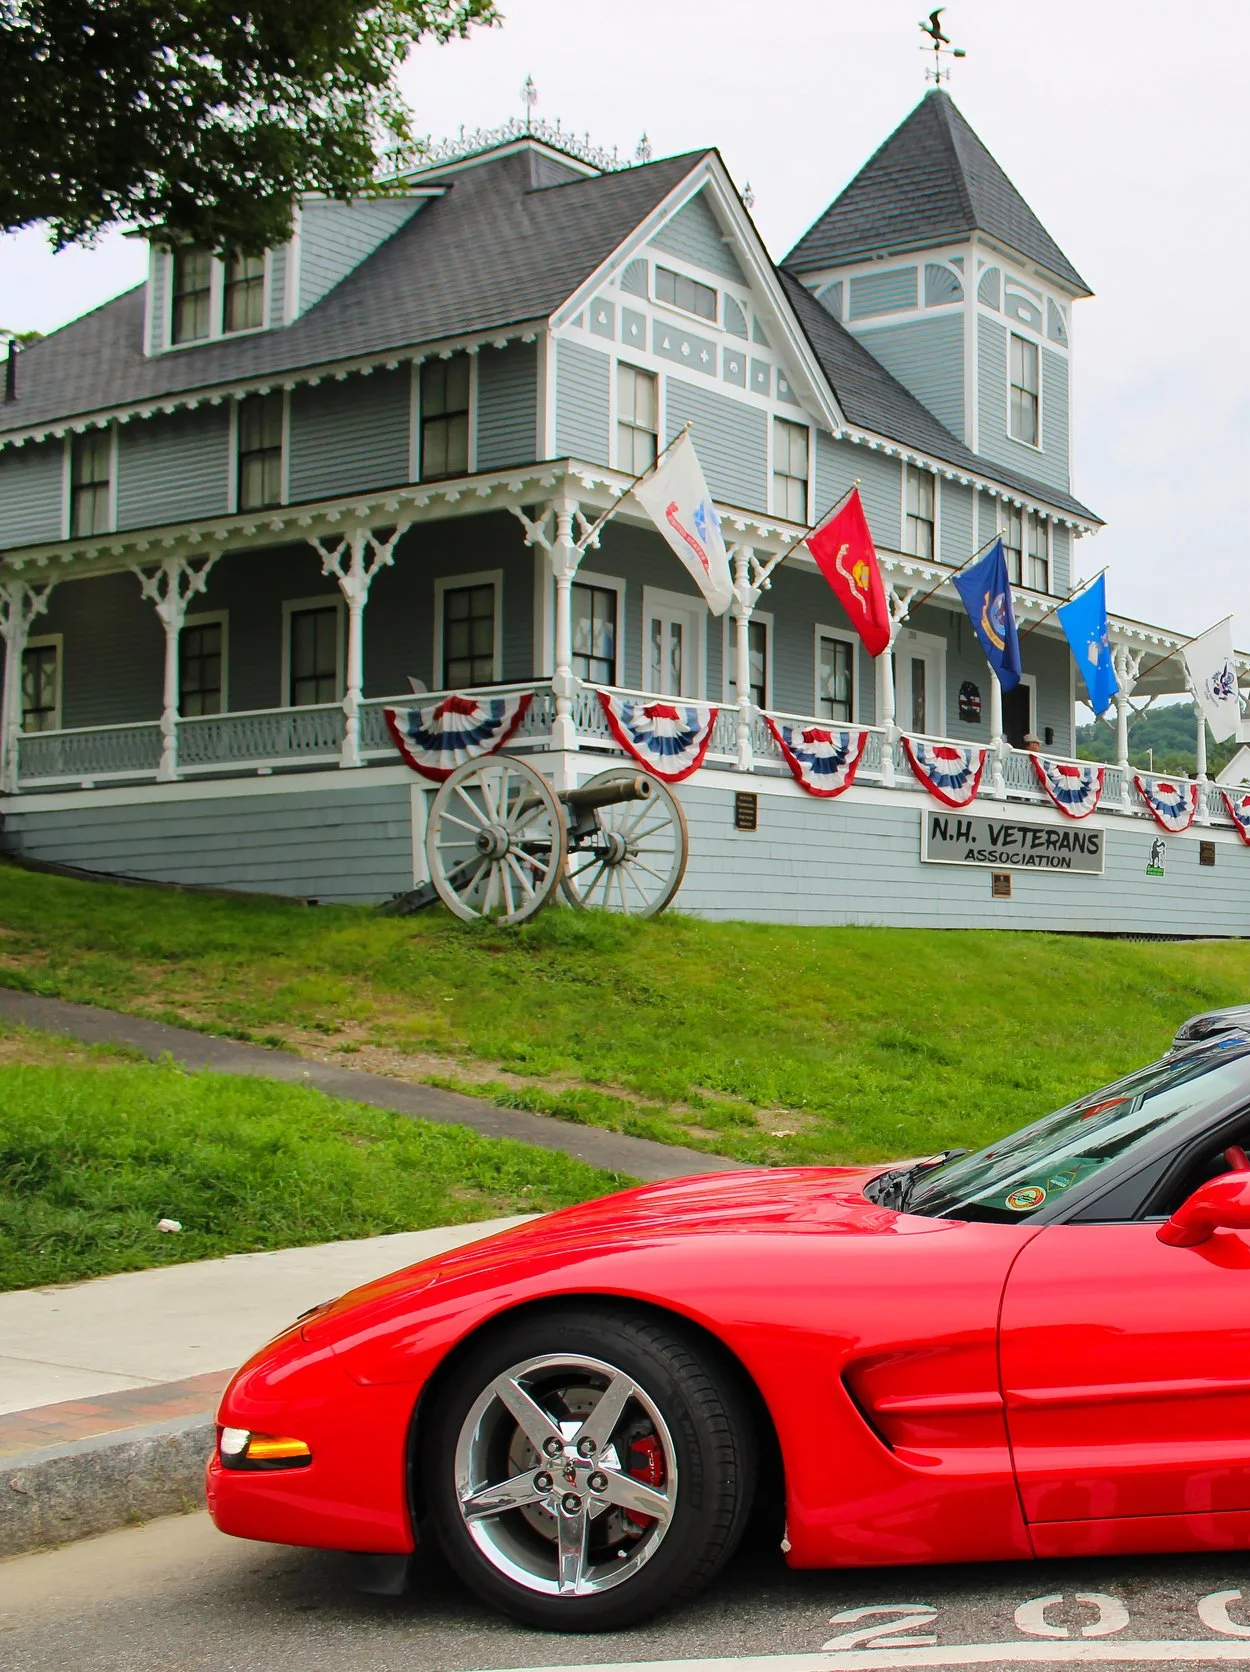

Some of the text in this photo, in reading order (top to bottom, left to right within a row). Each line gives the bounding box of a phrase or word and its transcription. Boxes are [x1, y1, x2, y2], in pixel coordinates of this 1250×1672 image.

[931, 817, 1100, 855] N.H. VETERANS
[964, 848, 1072, 869] ASSOCIATION
